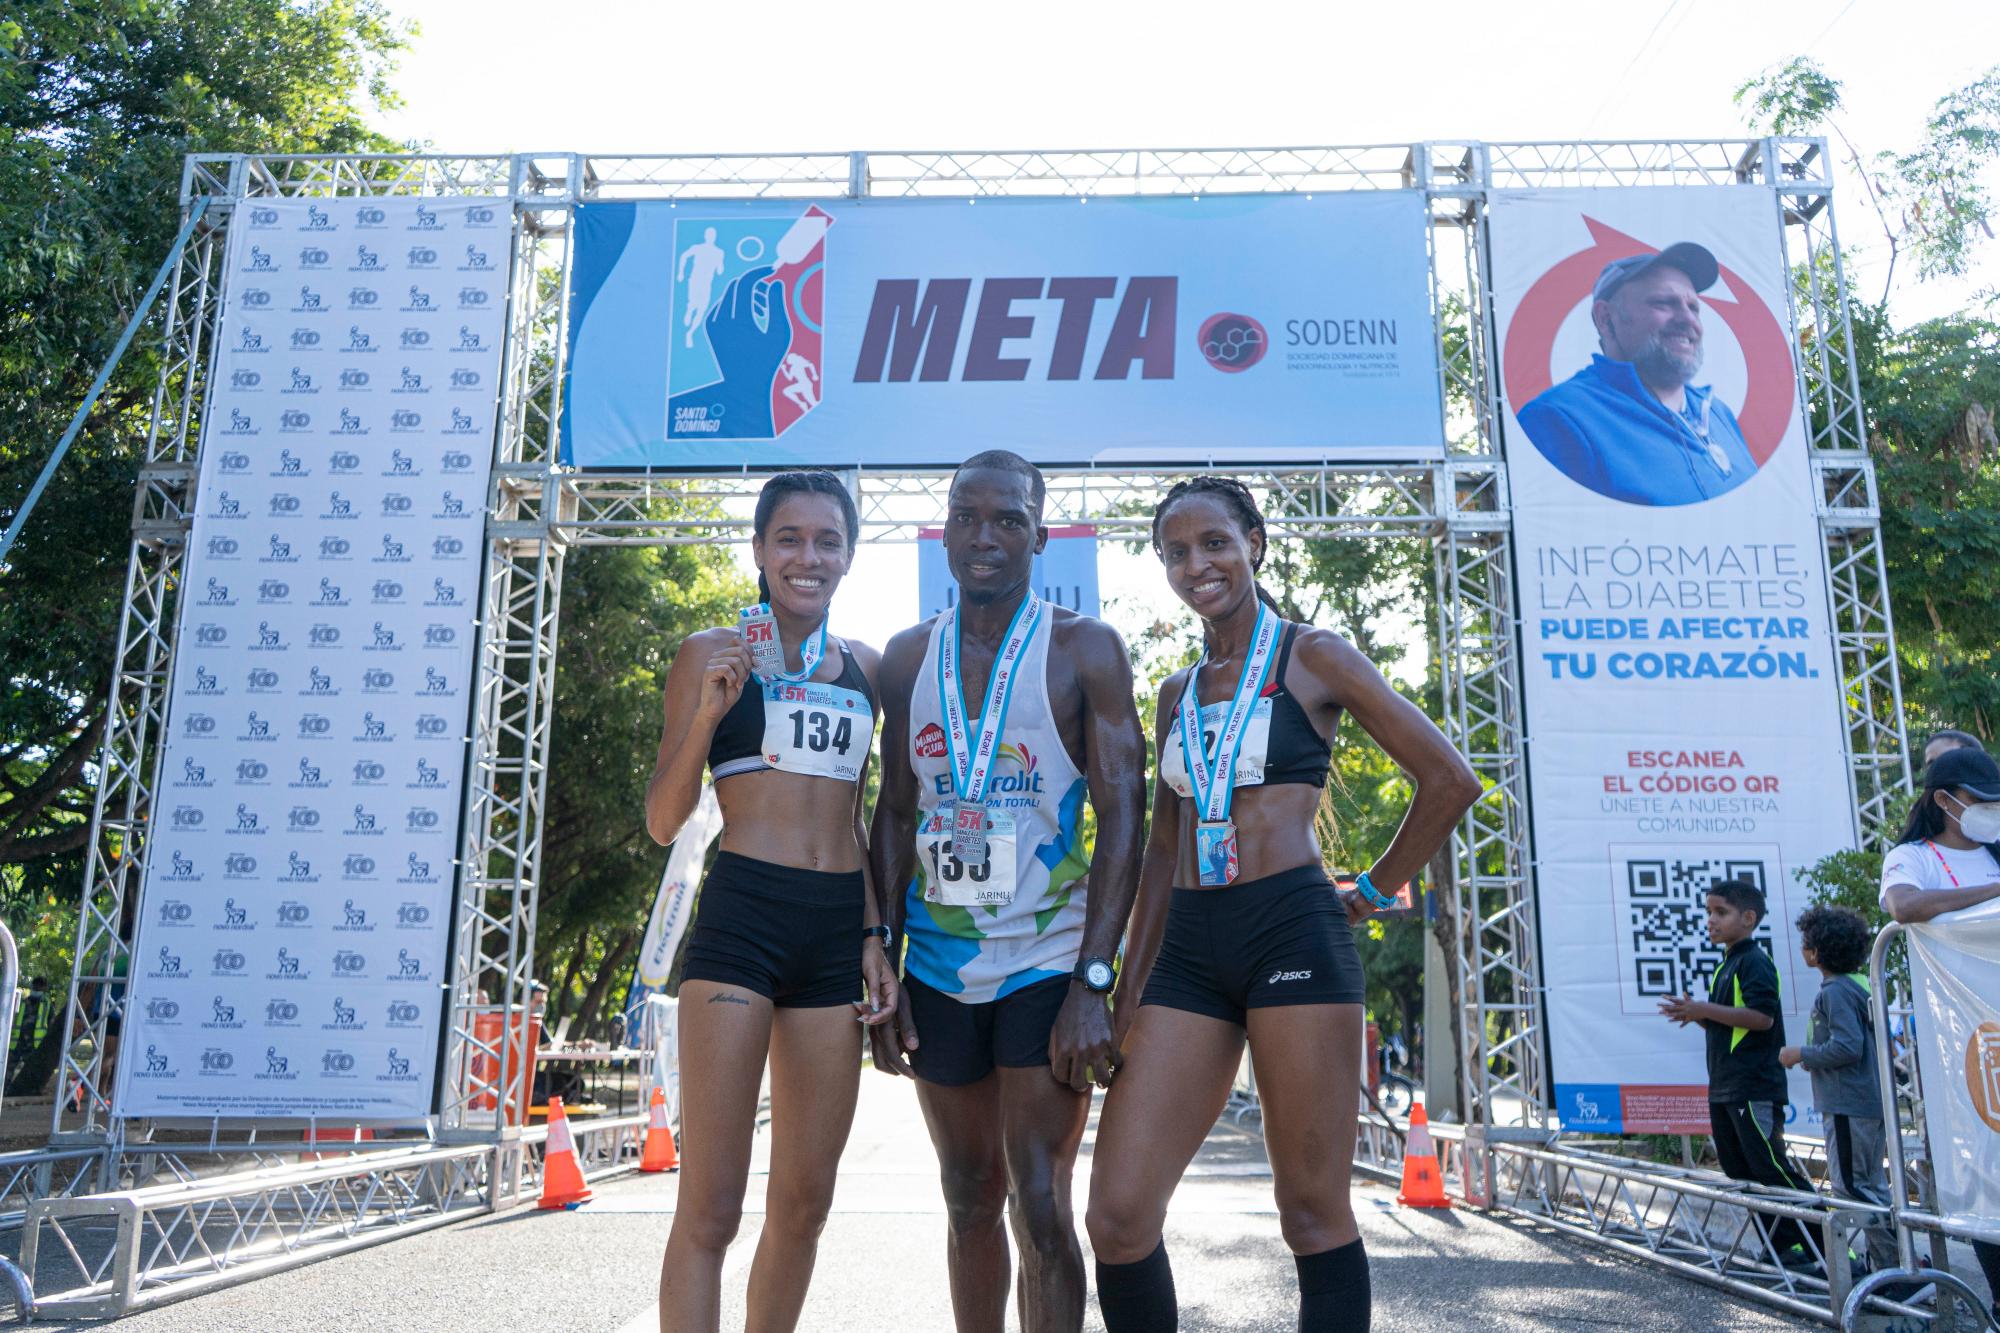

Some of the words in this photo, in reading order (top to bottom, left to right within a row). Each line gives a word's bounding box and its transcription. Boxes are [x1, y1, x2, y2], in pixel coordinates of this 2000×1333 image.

[853, 276, 1179, 383] META
[1286, 319, 1397, 346] SODENN
[674, 407, 707, 420] SANTO
[674, 419, 721, 433] DOMINGO
[1538, 538, 1809, 580] INFÓRMATE,
[1540, 581, 1592, 610] LA
[1607, 580, 1806, 609] DIABETES
[746, 622, 774, 643] 5K
[1541, 617, 1649, 640] PUEDE
[1657, 617, 1809, 639] AFECTAR
[1542, 652, 1596, 679] TU
[1607, 645, 1819, 679] CORAZÓN.
[785, 686, 808, 702] 5K
[789, 709, 852, 756] 134
[923, 741, 944, 757] CLUB
[1627, 751, 1744, 768] ESCANEA
[1603, 776, 1633, 793] EL
[1639, 771, 1737, 793] CÓDIGO
[1743, 776, 1779, 793] QR
[1004, 798, 1040, 808] TOTAL!
[1671, 797, 1683, 812] A
[1689, 797, 1779, 813] NUESTRA
[957, 810, 984, 831] 5K
[1637, 818, 1756, 833] COMUNIDAD
